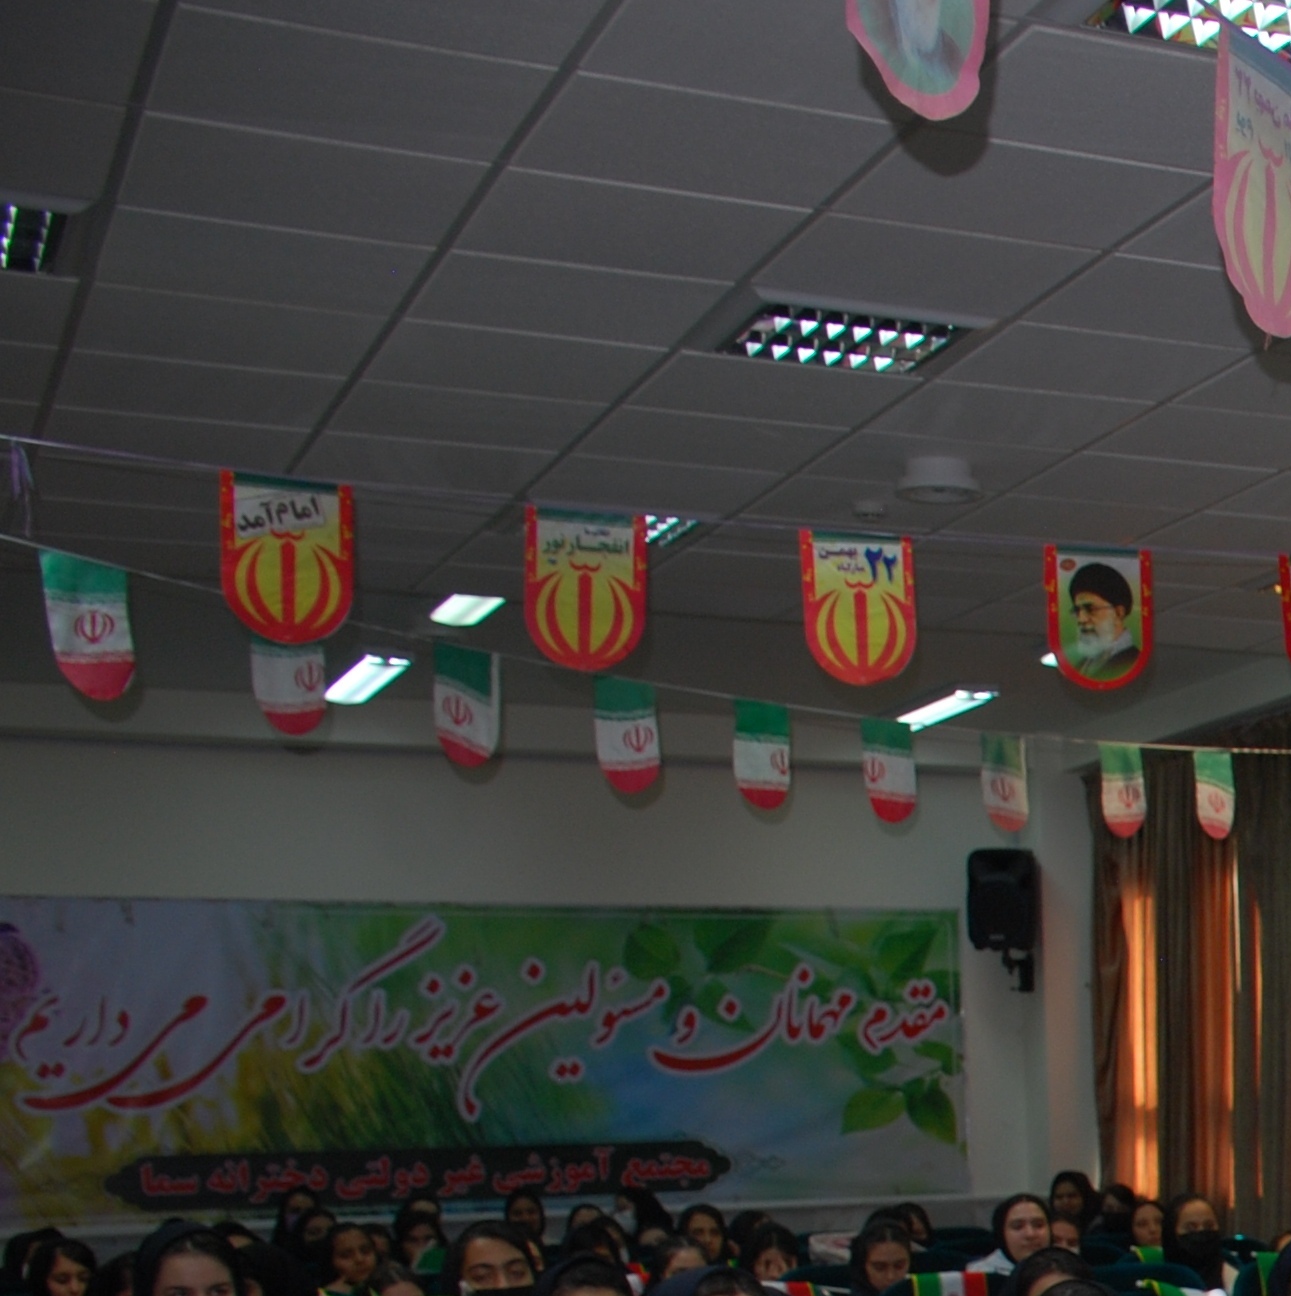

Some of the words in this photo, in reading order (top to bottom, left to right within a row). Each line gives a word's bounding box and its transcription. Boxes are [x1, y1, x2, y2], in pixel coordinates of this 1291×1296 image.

[237, 501, 275, 531] آمد
[274, 495, 319, 524] امام
[865, 546, 897, 582] ۲۲
[363, 992, 407, 1045] را
[415, 966, 500, 1059] عزیز
[651, 964, 854, 1074] مهمانان
[676, 1006, 697, 1045] و
[862, 982, 948, 1053] مقدم
[16, 997, 130, 1077] داریم
[22, 995, 208, 1111] می
[140, 1162, 198, 1196] سما
[206, 1158, 329, 1203] دخترانه
[335, 1155, 429, 1199] دولتی
[437, 1153, 486, 1196] غیر
[493, 1147, 613, 1192] آموزشی
[622, 1152, 711, 1188] مجتمع
